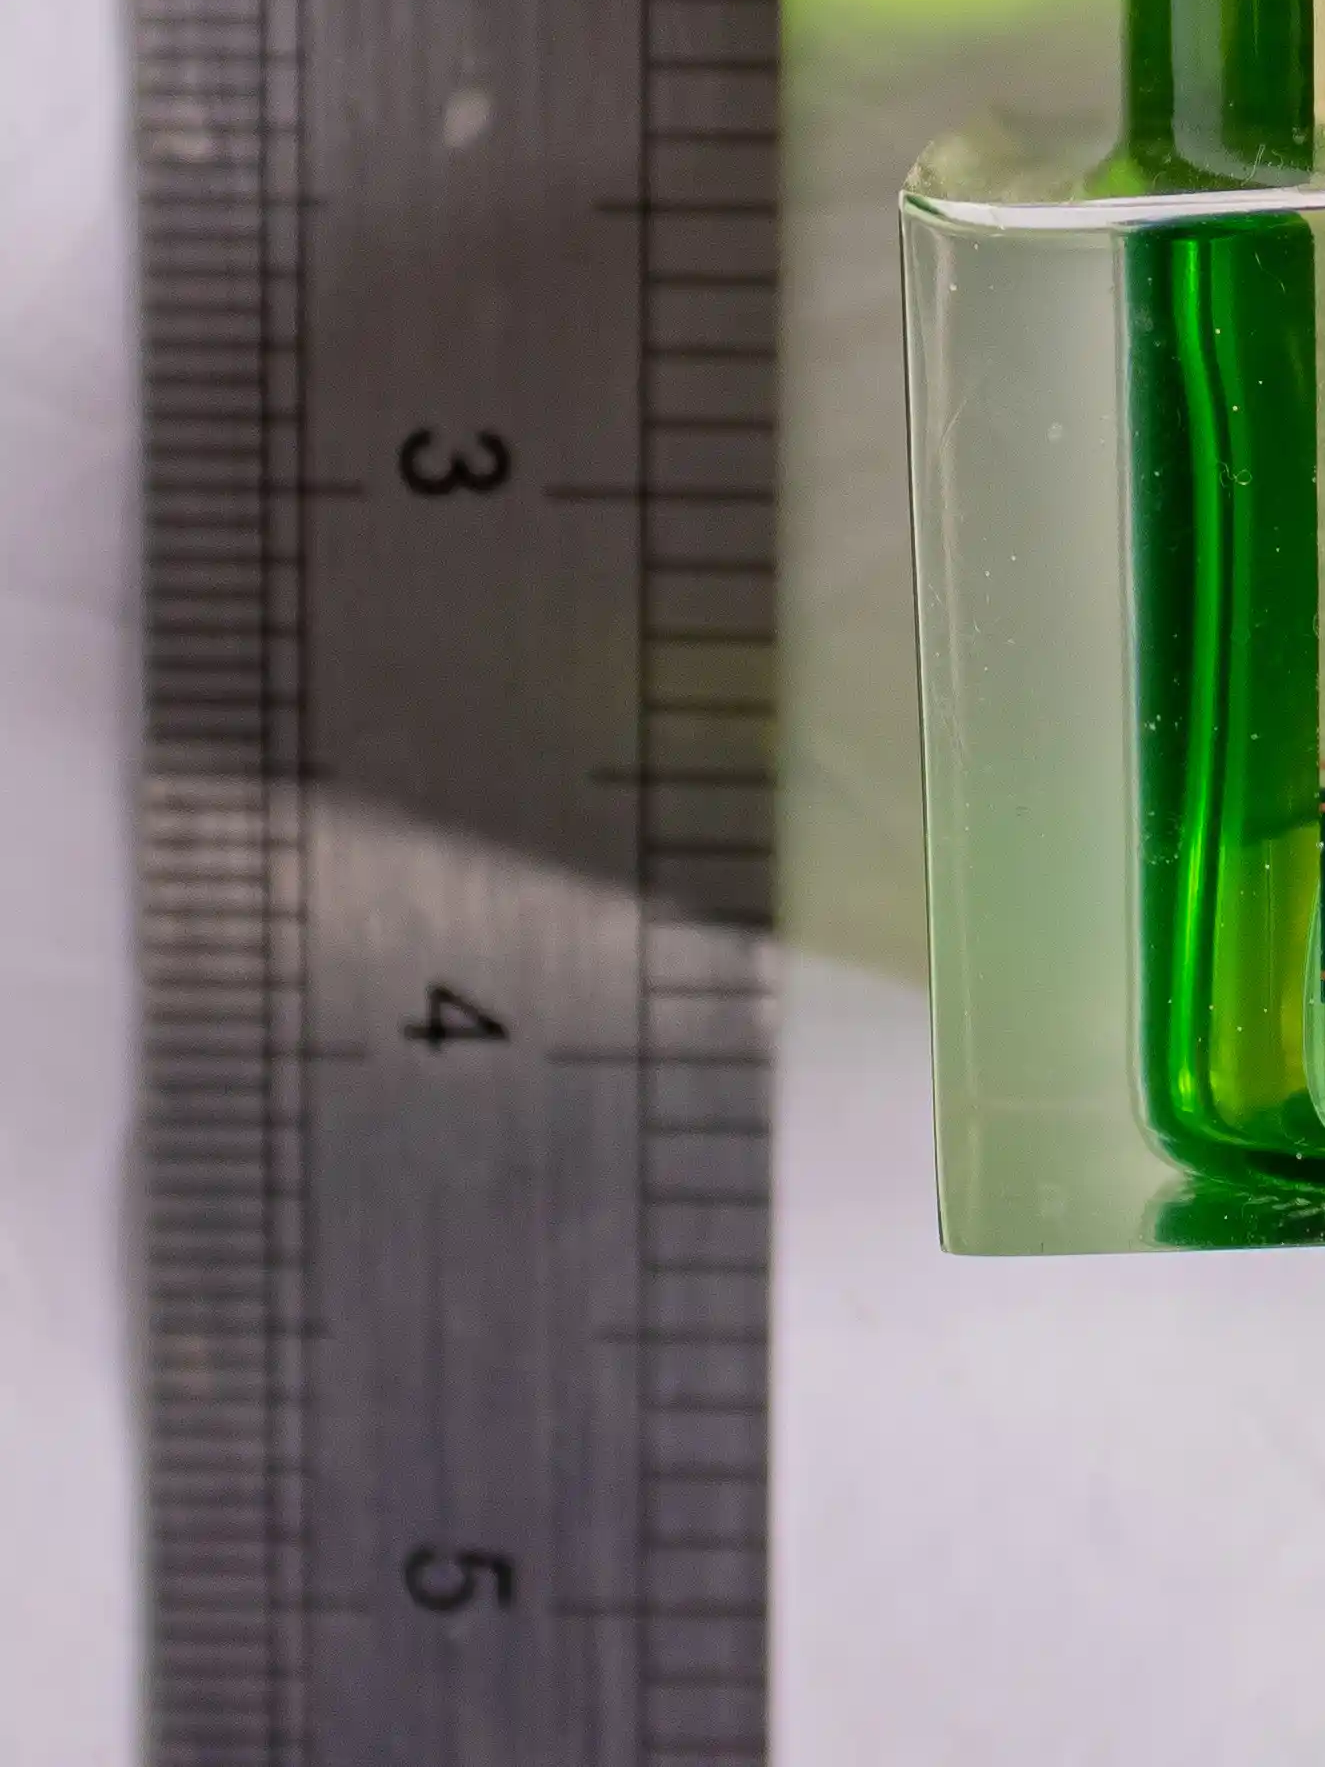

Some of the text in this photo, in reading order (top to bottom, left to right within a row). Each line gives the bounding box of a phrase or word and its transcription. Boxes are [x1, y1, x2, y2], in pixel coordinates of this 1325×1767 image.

[399, 429, 511, 496] 3
[403, 983, 510, 1053] 4
[403, 1545, 515, 1612] 5
